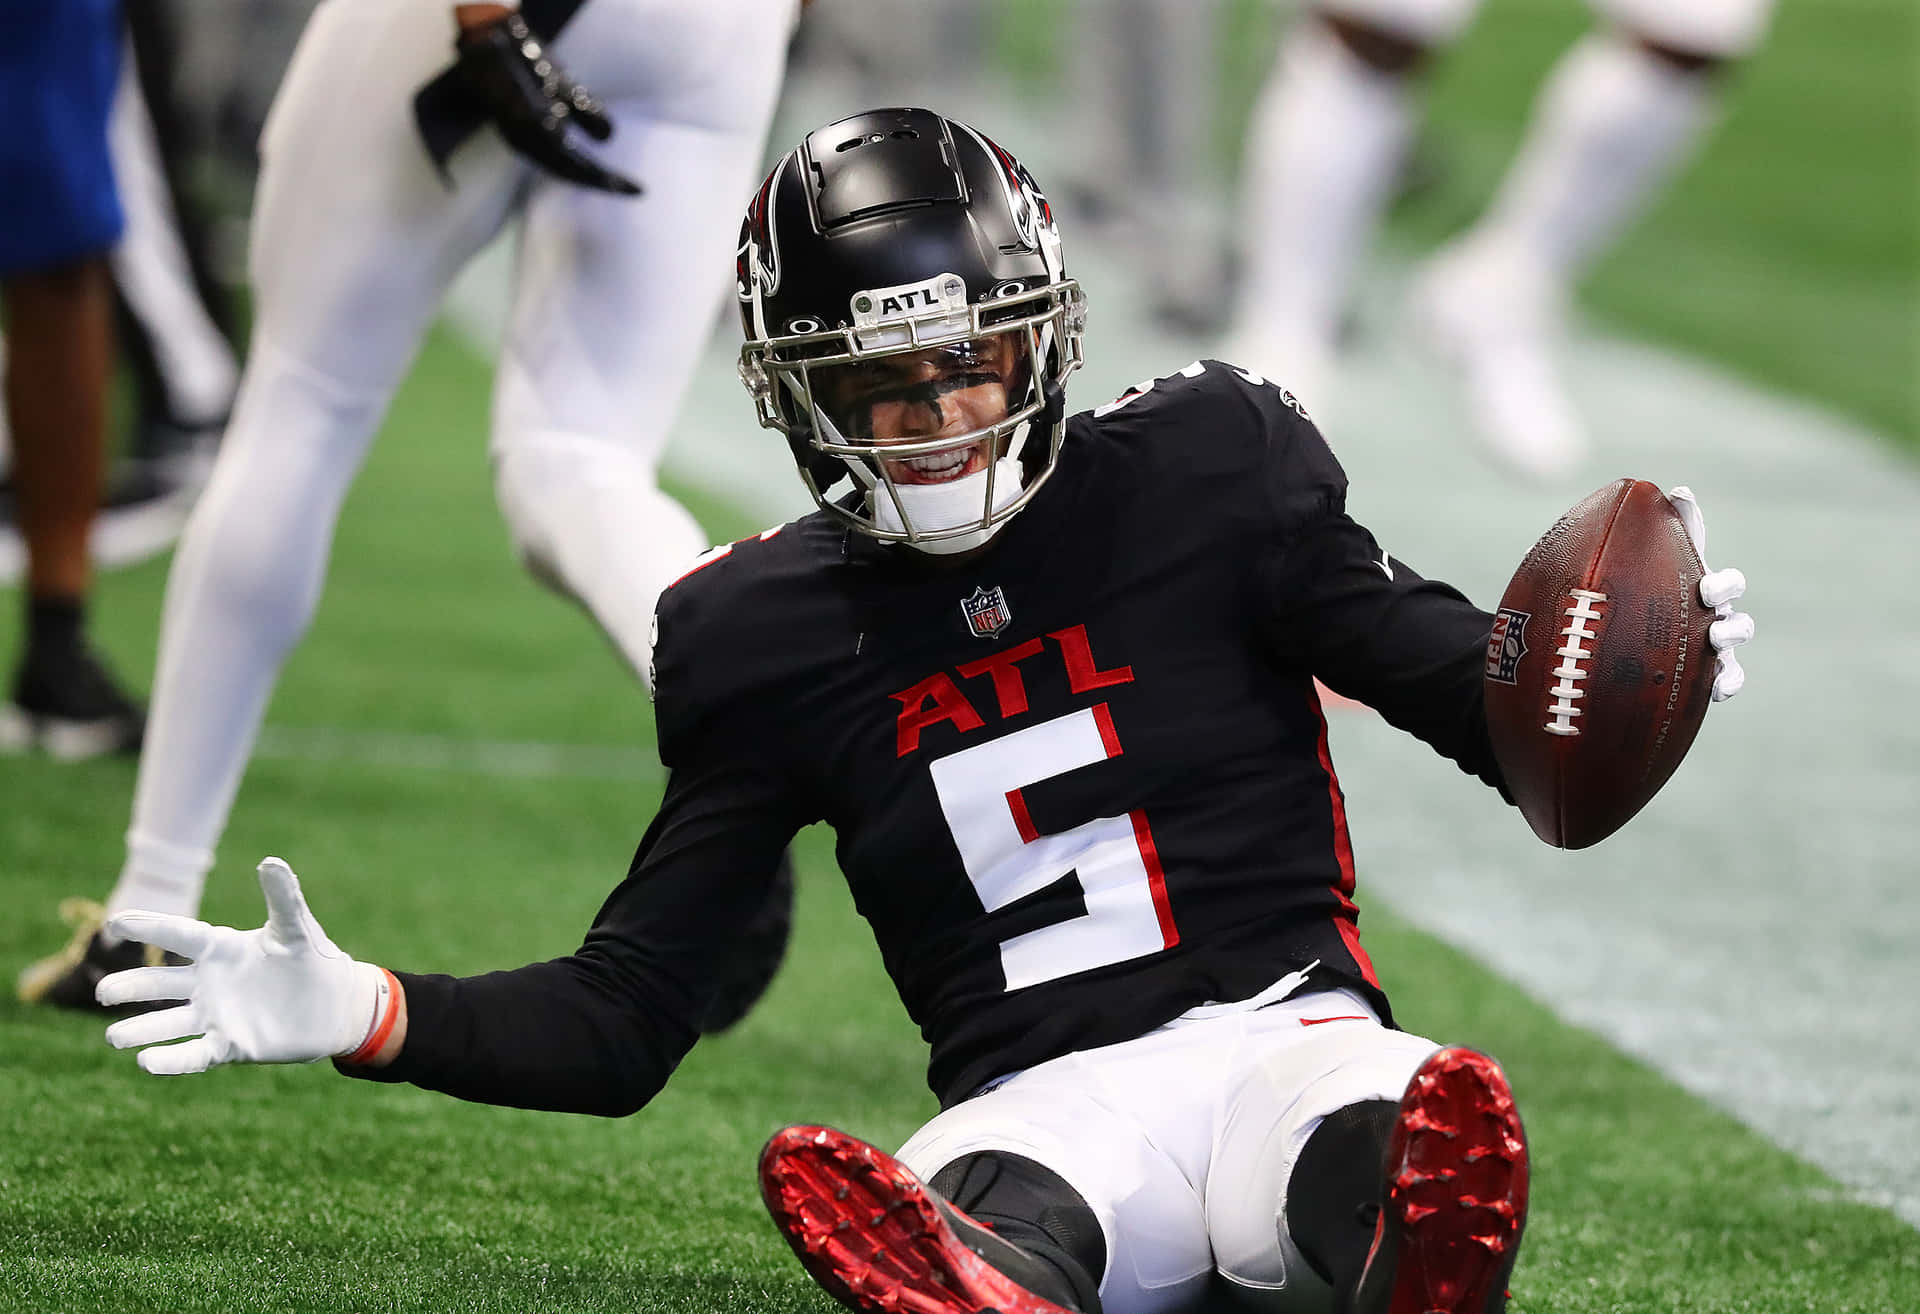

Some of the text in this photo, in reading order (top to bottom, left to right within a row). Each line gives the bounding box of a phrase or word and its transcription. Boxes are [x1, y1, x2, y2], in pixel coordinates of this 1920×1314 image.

[881, 289, 939, 316] ATL
[973, 607, 1006, 631] NFL
[1486, 616, 1509, 672] NFL
[1667, 634, 1688, 711] FOOTBALL
[1679, 571, 1689, 628] LEAGUE
[888, 623, 1135, 759] ATL
[929, 701, 1181, 993] 5
